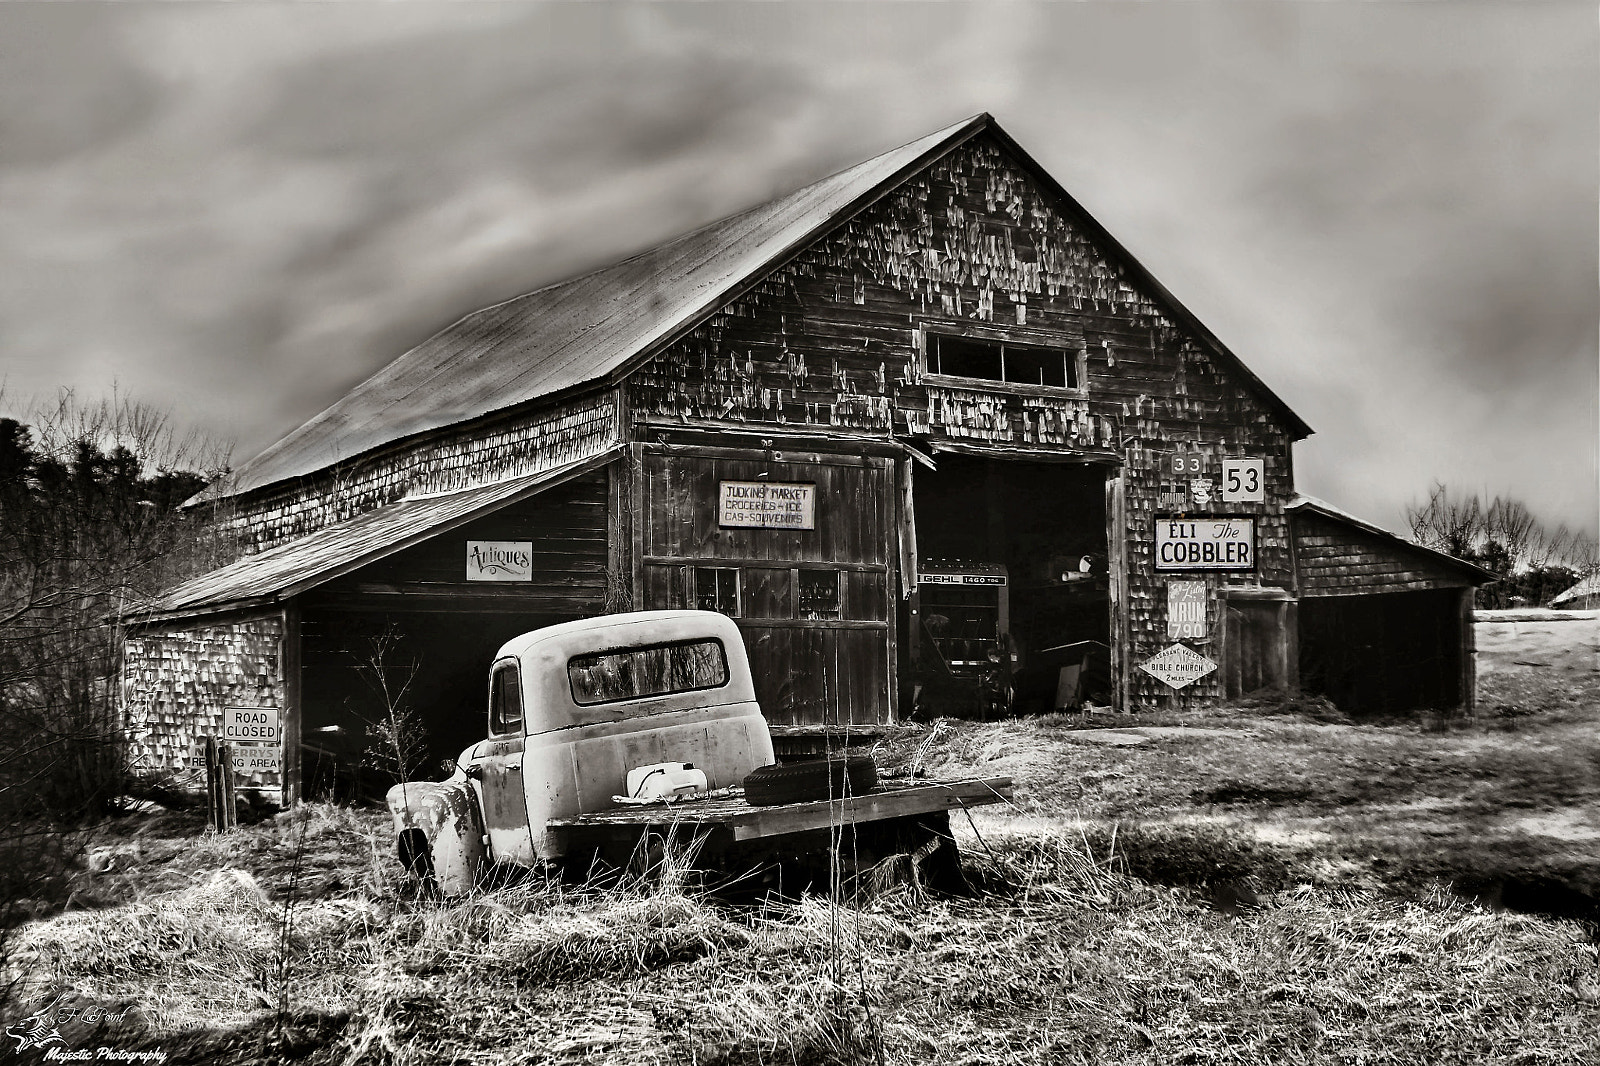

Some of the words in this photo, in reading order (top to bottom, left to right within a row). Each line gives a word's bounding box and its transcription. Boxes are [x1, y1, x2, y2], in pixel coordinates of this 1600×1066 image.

[1227, 467, 1259, 493] 53
[771, 488, 808, 500] MARKET
[785, 502, 802, 512] ICE
[1169, 523, 1196, 539] ELI
[1212, 522, 1240, 539] The
[1160, 541, 1249, 563] COBBLER
[469, 545, 530, 574] Antiques
[923, 575, 960, 583] GEHL
[1172, 623, 1203, 638] 790
[1151, 663, 1172, 671] BIBLE
[1175, 664, 1203, 672] CHURCH
[235, 712, 268, 724] ROAD
[227, 726, 275, 738] CLOSED
[249, 759, 277, 768] AREA
